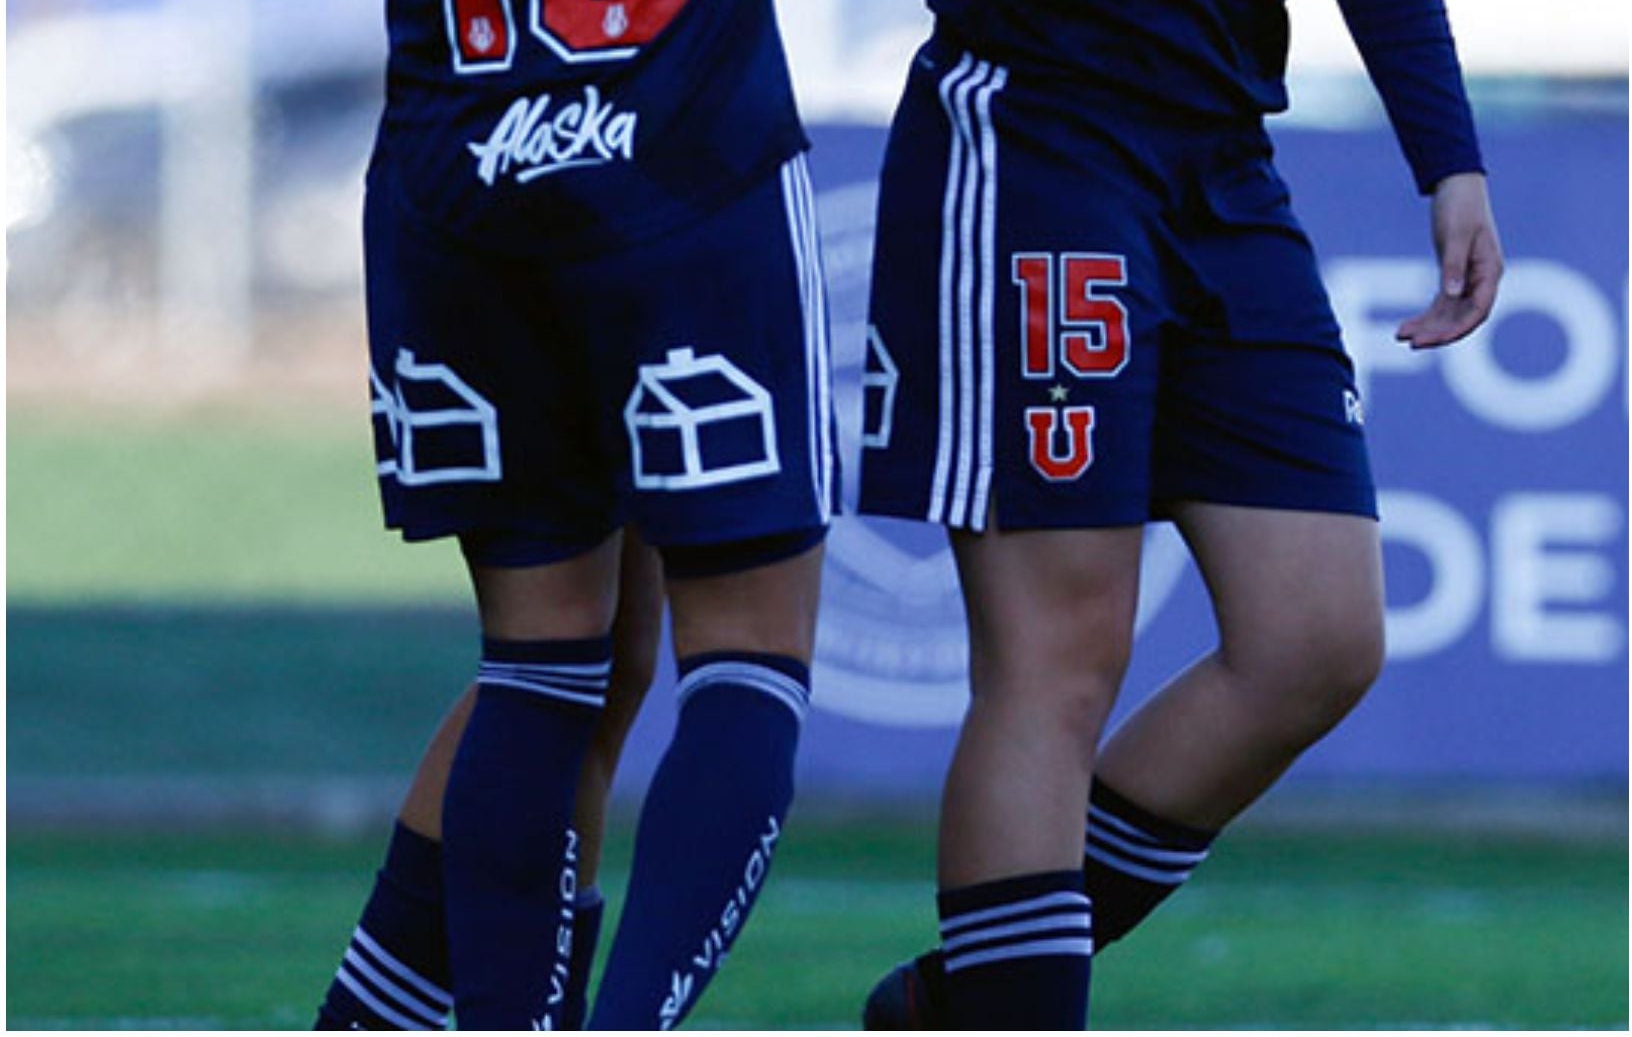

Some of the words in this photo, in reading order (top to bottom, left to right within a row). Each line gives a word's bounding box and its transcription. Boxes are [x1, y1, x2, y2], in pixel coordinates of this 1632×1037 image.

[466, 83, 638, 188] Alaska
[1011, 252, 1130, 377] 15
[1025, 406, 1095, 482] U
[693, 815, 780, 969] VISION
